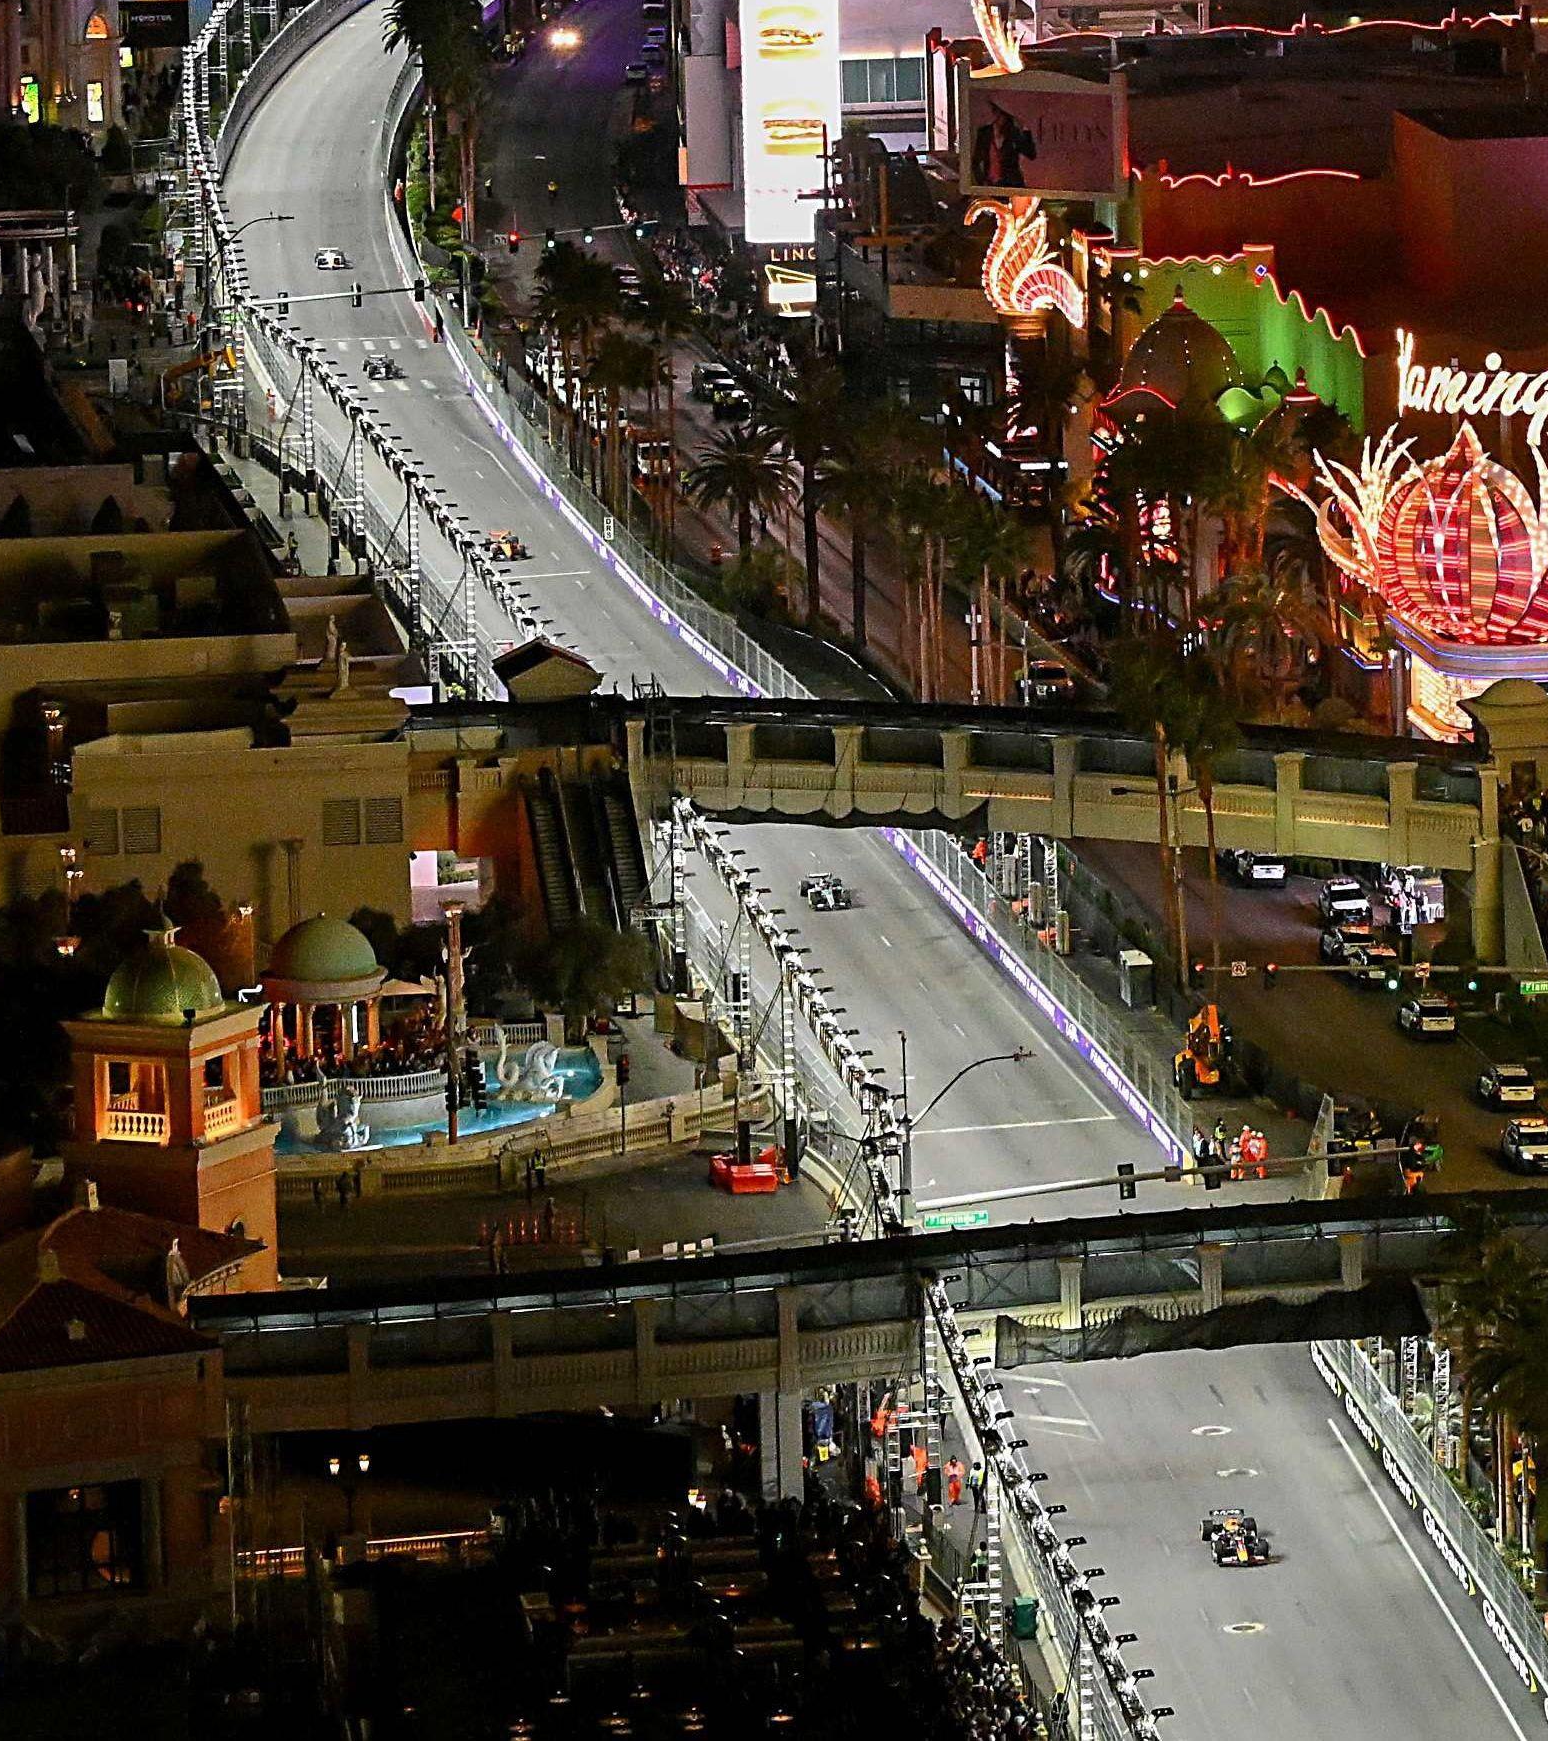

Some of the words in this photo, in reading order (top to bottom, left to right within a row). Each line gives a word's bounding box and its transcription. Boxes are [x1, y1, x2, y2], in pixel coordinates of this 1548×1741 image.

[605, 518, 613, 540] DRS
[1345, 1392, 1375, 1448] Globant
[1382, 1446, 1414, 1507] Globant
[1423, 1507, 1470, 1591] Globant
[1482, 1599, 1533, 1688] Globant
